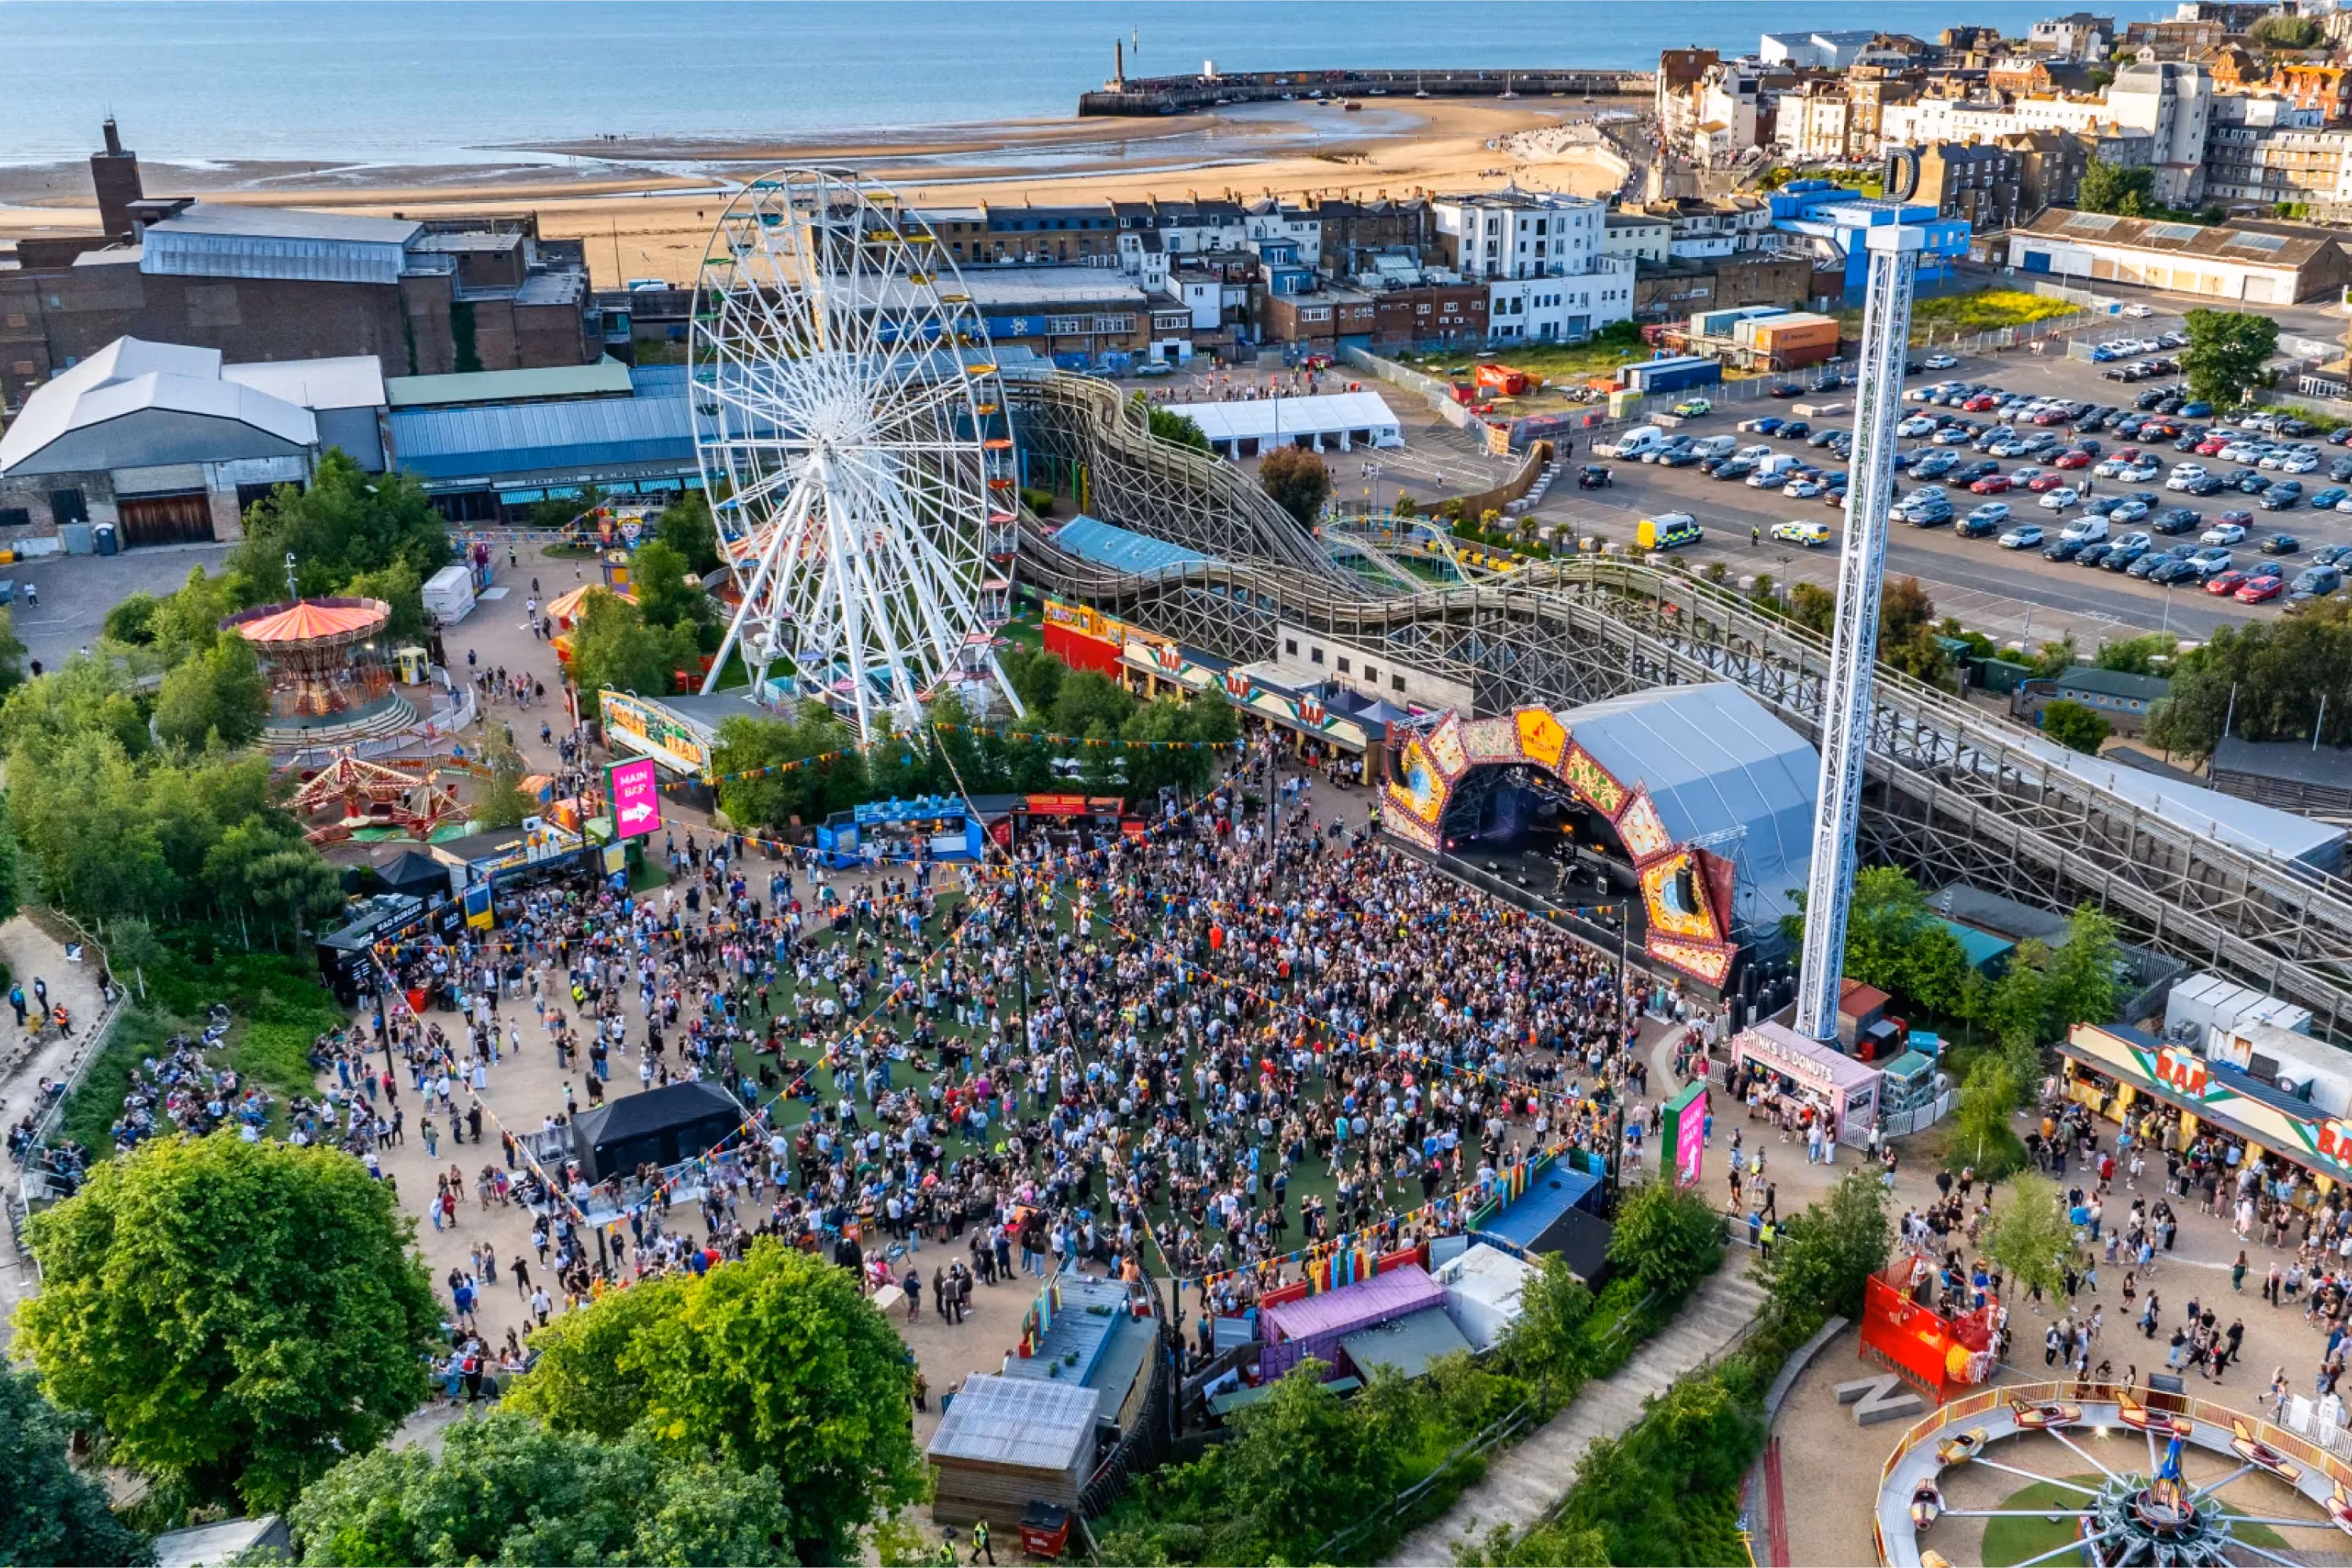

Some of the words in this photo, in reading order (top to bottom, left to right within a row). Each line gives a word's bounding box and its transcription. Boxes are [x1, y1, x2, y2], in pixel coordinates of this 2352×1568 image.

[1160, 650, 1181, 671] BAR
[1226, 676, 1250, 698] BAR
[1298, 701, 1324, 725] BAR
[620, 771, 648, 786] MAIN
[1743, 1027, 1777, 1054] DRINKS
[1792, 1051, 1833, 1082] DONUTS
[2156, 1053, 2208, 1098] BAR
